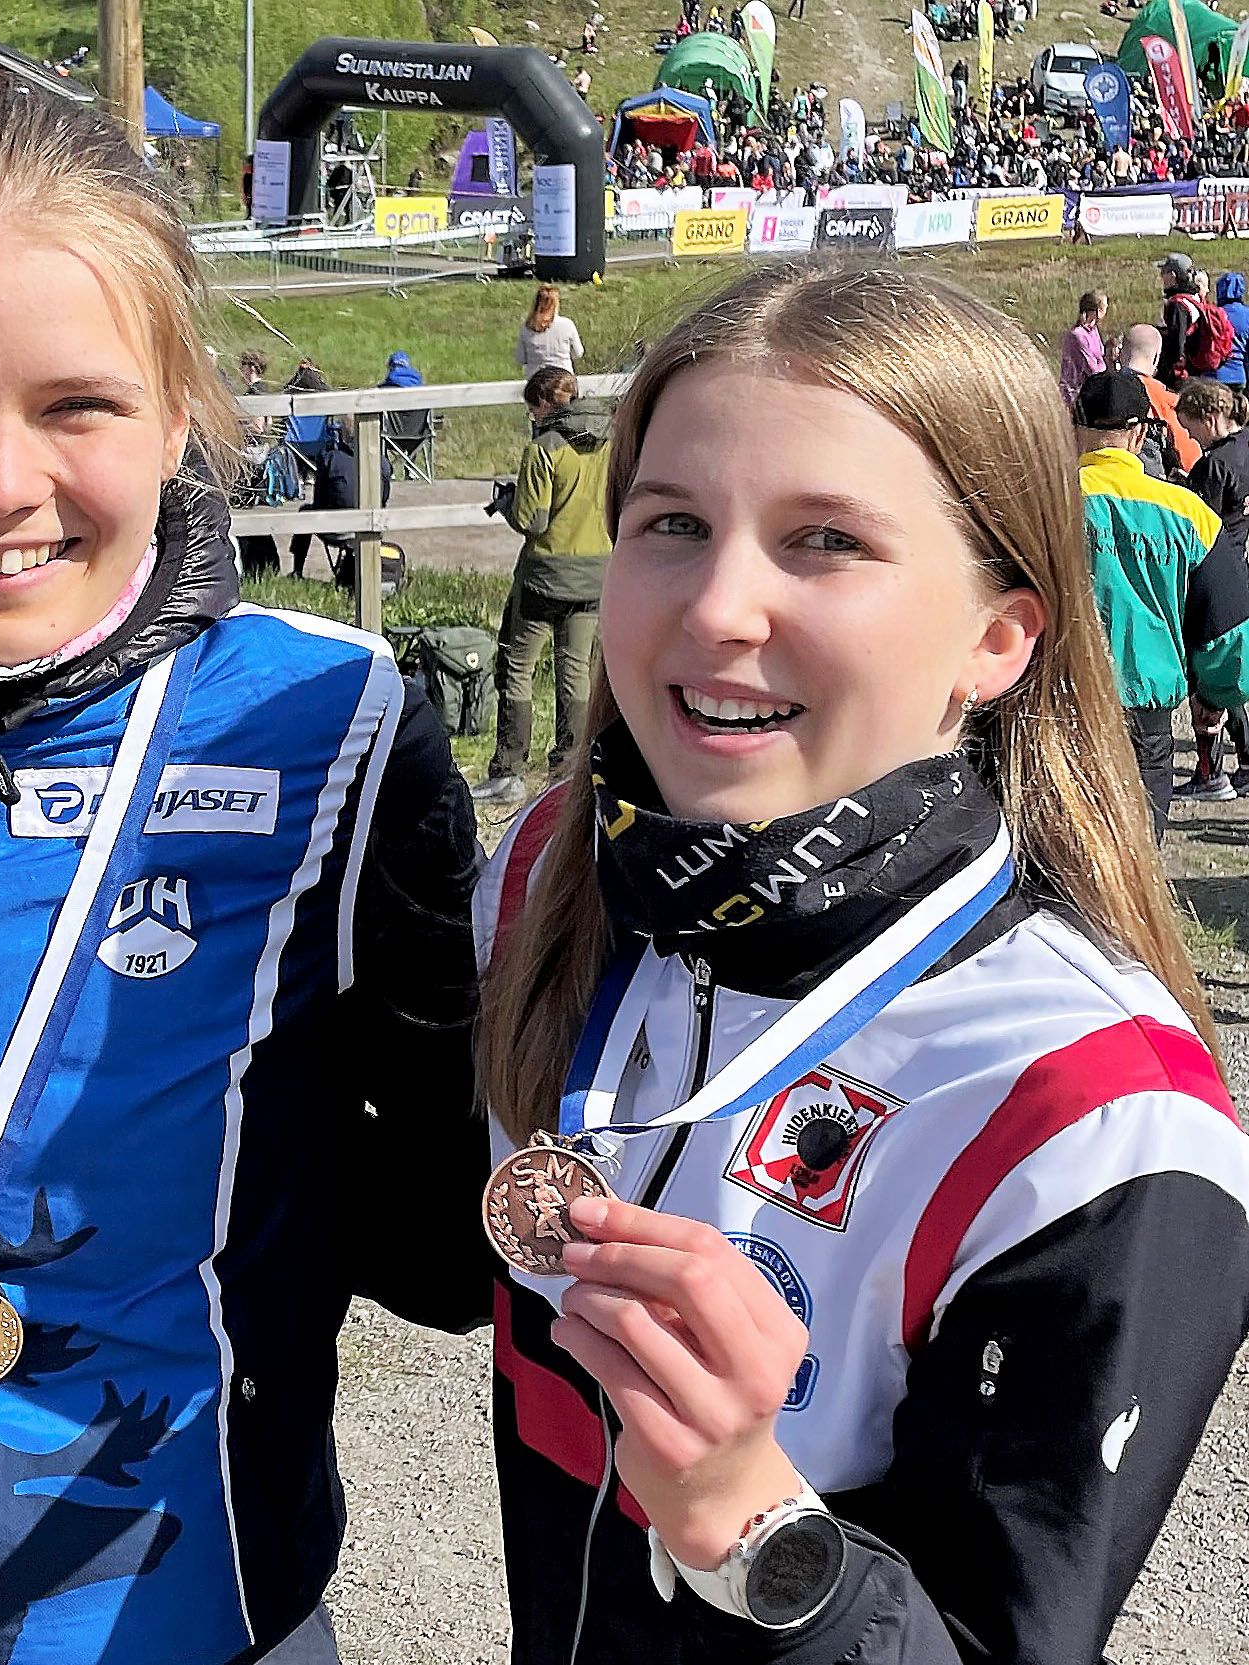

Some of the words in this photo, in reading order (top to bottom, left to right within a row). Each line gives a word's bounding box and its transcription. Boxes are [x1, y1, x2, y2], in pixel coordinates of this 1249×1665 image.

[336, 52, 472, 82] SUUNNISTAJAN
[365, 82, 444, 106] KAUPPA
[459, 209, 511, 227] CRAFT
[990, 208, 1049, 226] GRANO
[684, 221, 735, 241] GRANO
[825, 219, 872, 237] CRAFT
[125, 949, 167, 974] 1927
